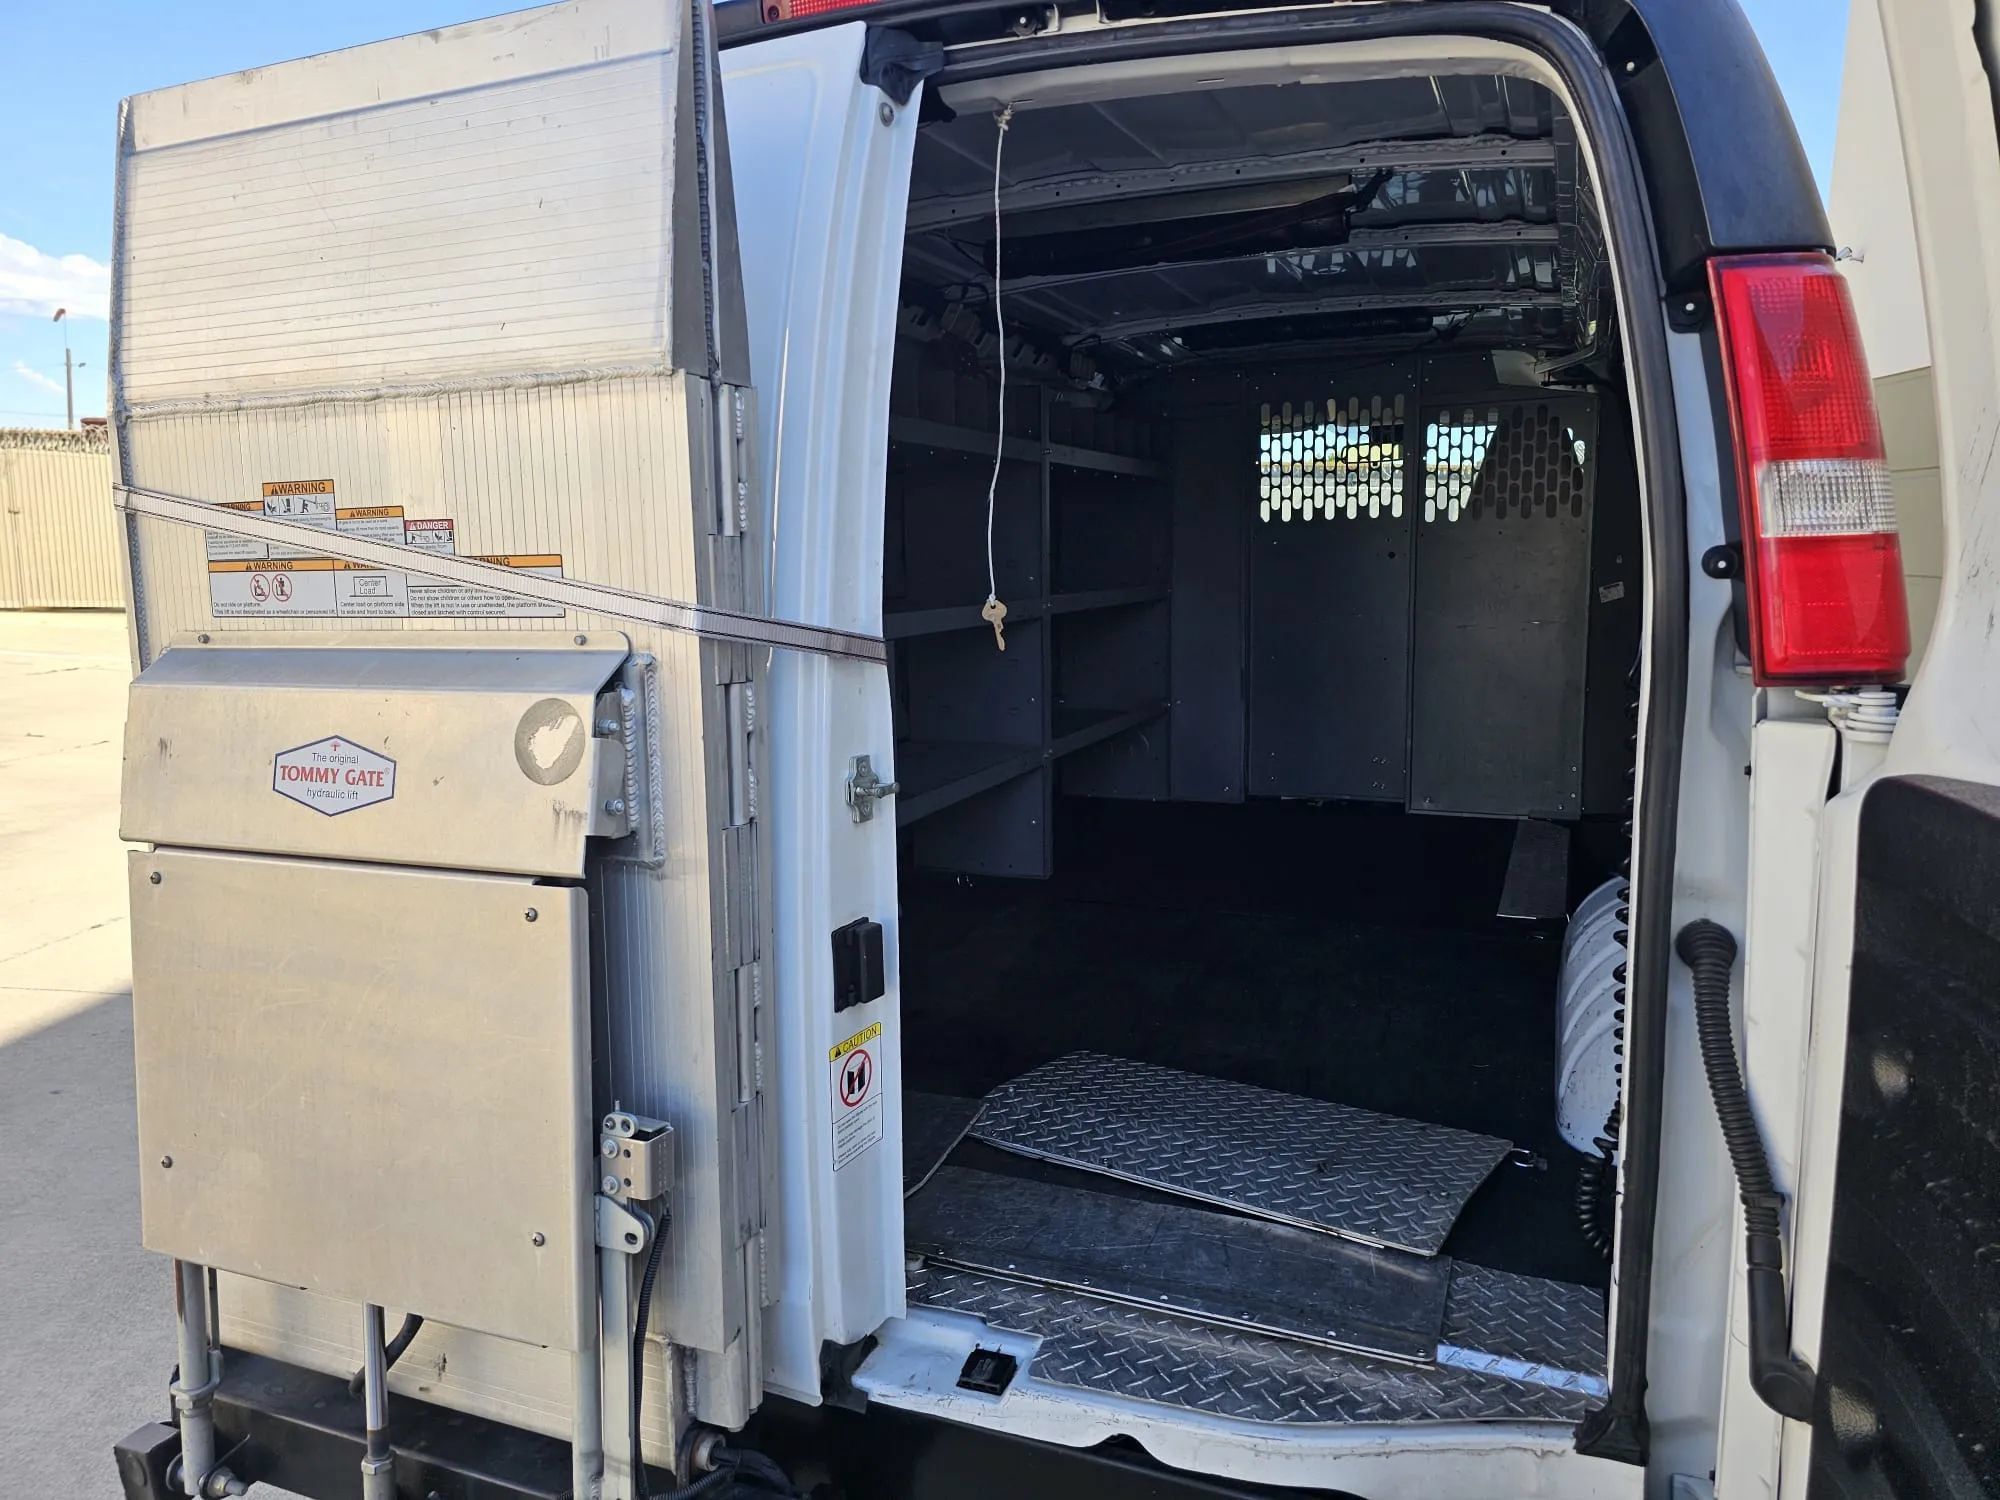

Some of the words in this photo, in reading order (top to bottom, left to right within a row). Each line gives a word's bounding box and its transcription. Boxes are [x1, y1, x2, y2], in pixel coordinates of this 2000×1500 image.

[278, 482, 326, 494] WARNING
[356, 508, 389, 517] WARNING
[254, 562, 293, 570] WARNING
[312, 753, 327, 762] The
[330, 754, 359, 765] original
[280, 765, 339, 784] TOMMY
[345, 769, 384, 787] GATE
[307, 788, 345, 799] hydraulic
[348, 790, 358, 800] lift
[842, 1026, 877, 1053] CAUTION
